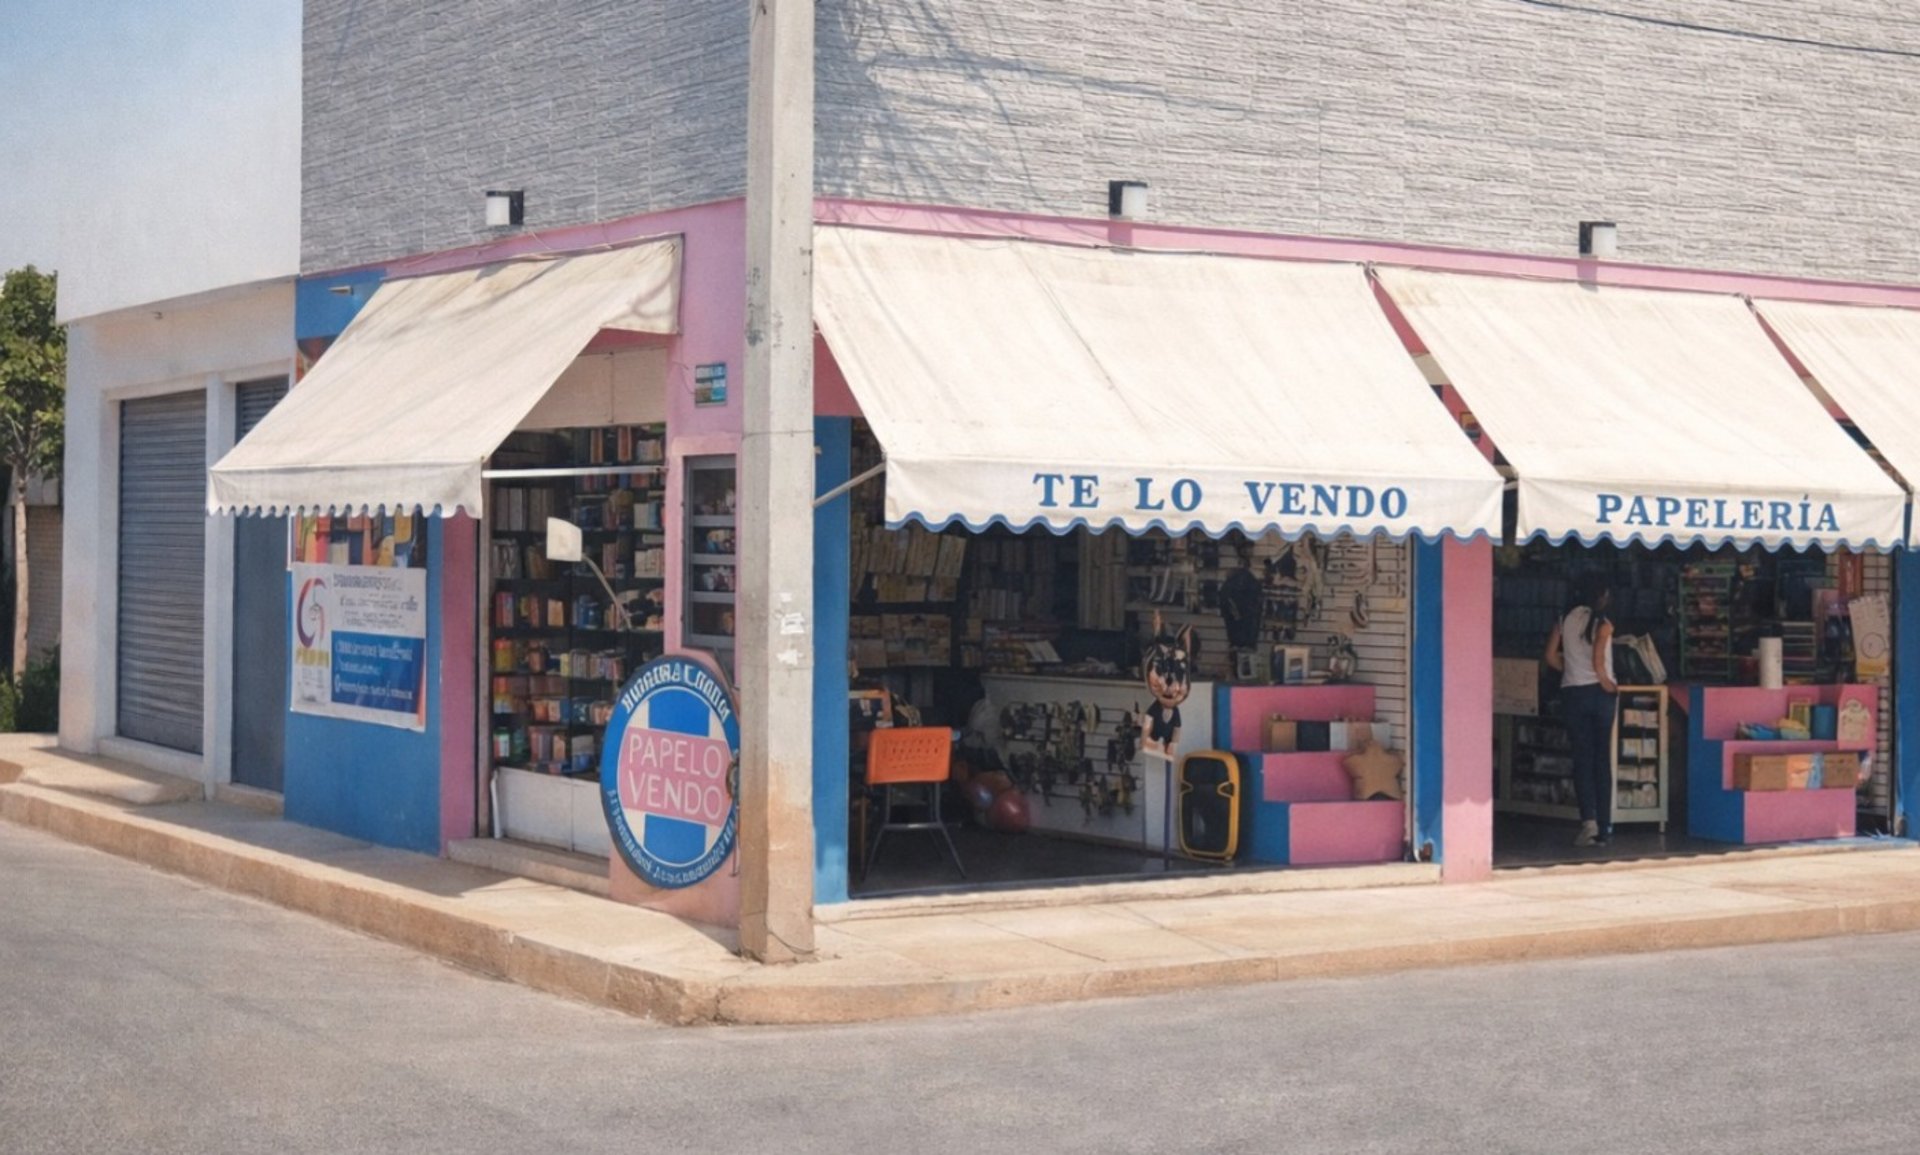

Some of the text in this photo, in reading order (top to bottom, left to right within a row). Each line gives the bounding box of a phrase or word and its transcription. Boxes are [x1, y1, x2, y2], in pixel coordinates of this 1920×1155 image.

[1033, 473, 1408, 519] TE LO VENDO
[1596, 493, 1841, 532] PAPELERÍA
[628, 733, 723, 780] PAPELO
[627, 769, 724, 821] VENDO
